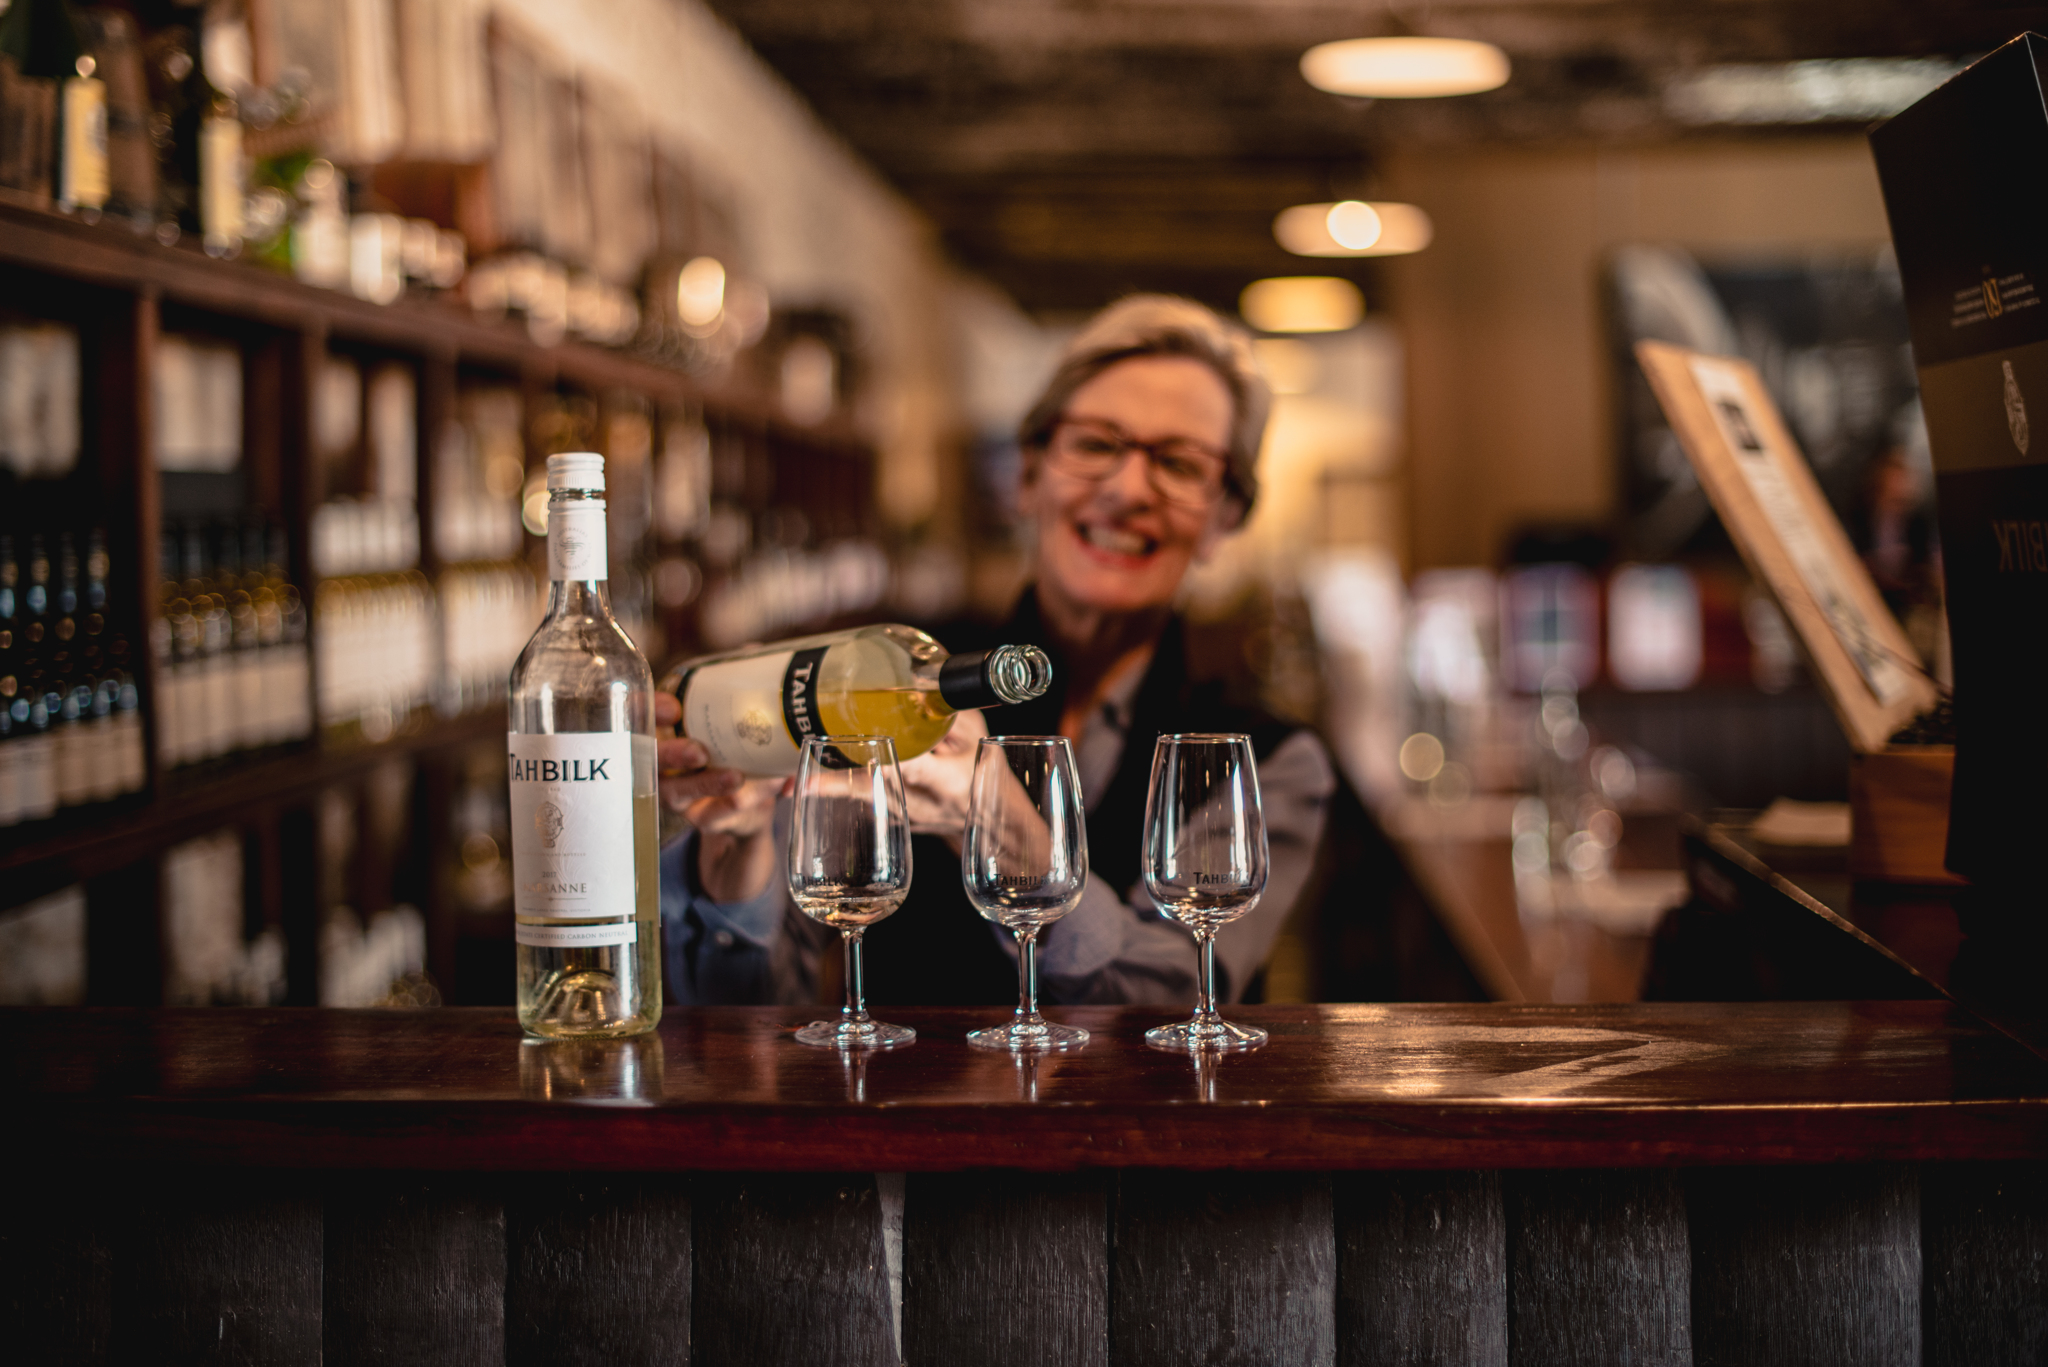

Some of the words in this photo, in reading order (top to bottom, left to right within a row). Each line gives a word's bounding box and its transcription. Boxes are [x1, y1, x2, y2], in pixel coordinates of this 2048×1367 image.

[1992, 520, 2048, 573] BILK
[791, 661, 840, 764] TAHBIK
[510, 753, 611, 781] TAHBILK
[542, 871, 557, 879] 2017
[598, 930, 628, 939] NEUTRAL
